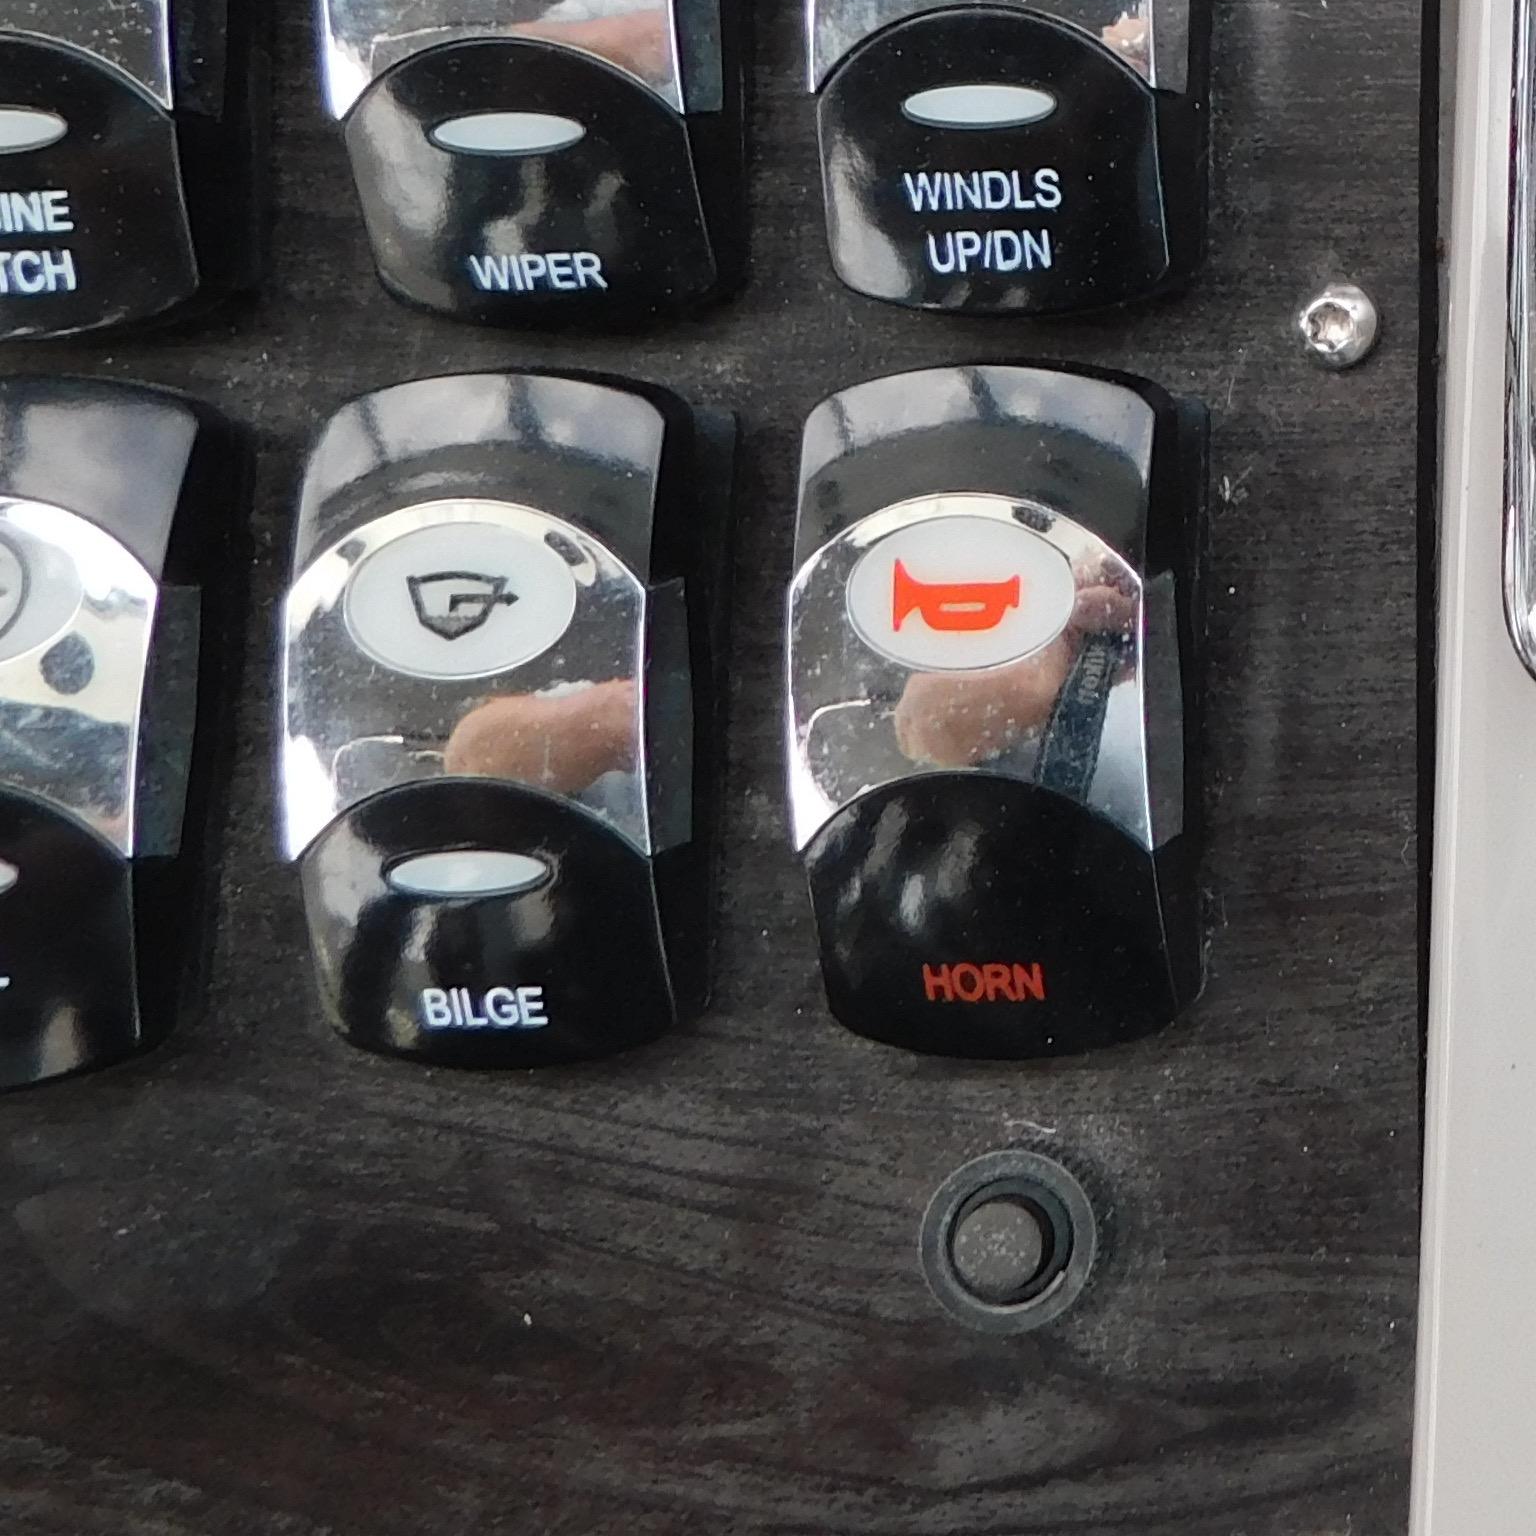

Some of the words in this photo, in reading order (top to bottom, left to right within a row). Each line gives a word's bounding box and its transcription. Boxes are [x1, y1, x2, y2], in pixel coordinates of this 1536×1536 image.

[904, 168, 1063, 212] WINDLS
[470, 251, 608, 292] WIPER
[928, 228, 1054, 272] UP/DN
[922, 963, 1046, 1003] HORN
[422, 986, 549, 1030] BILGE
